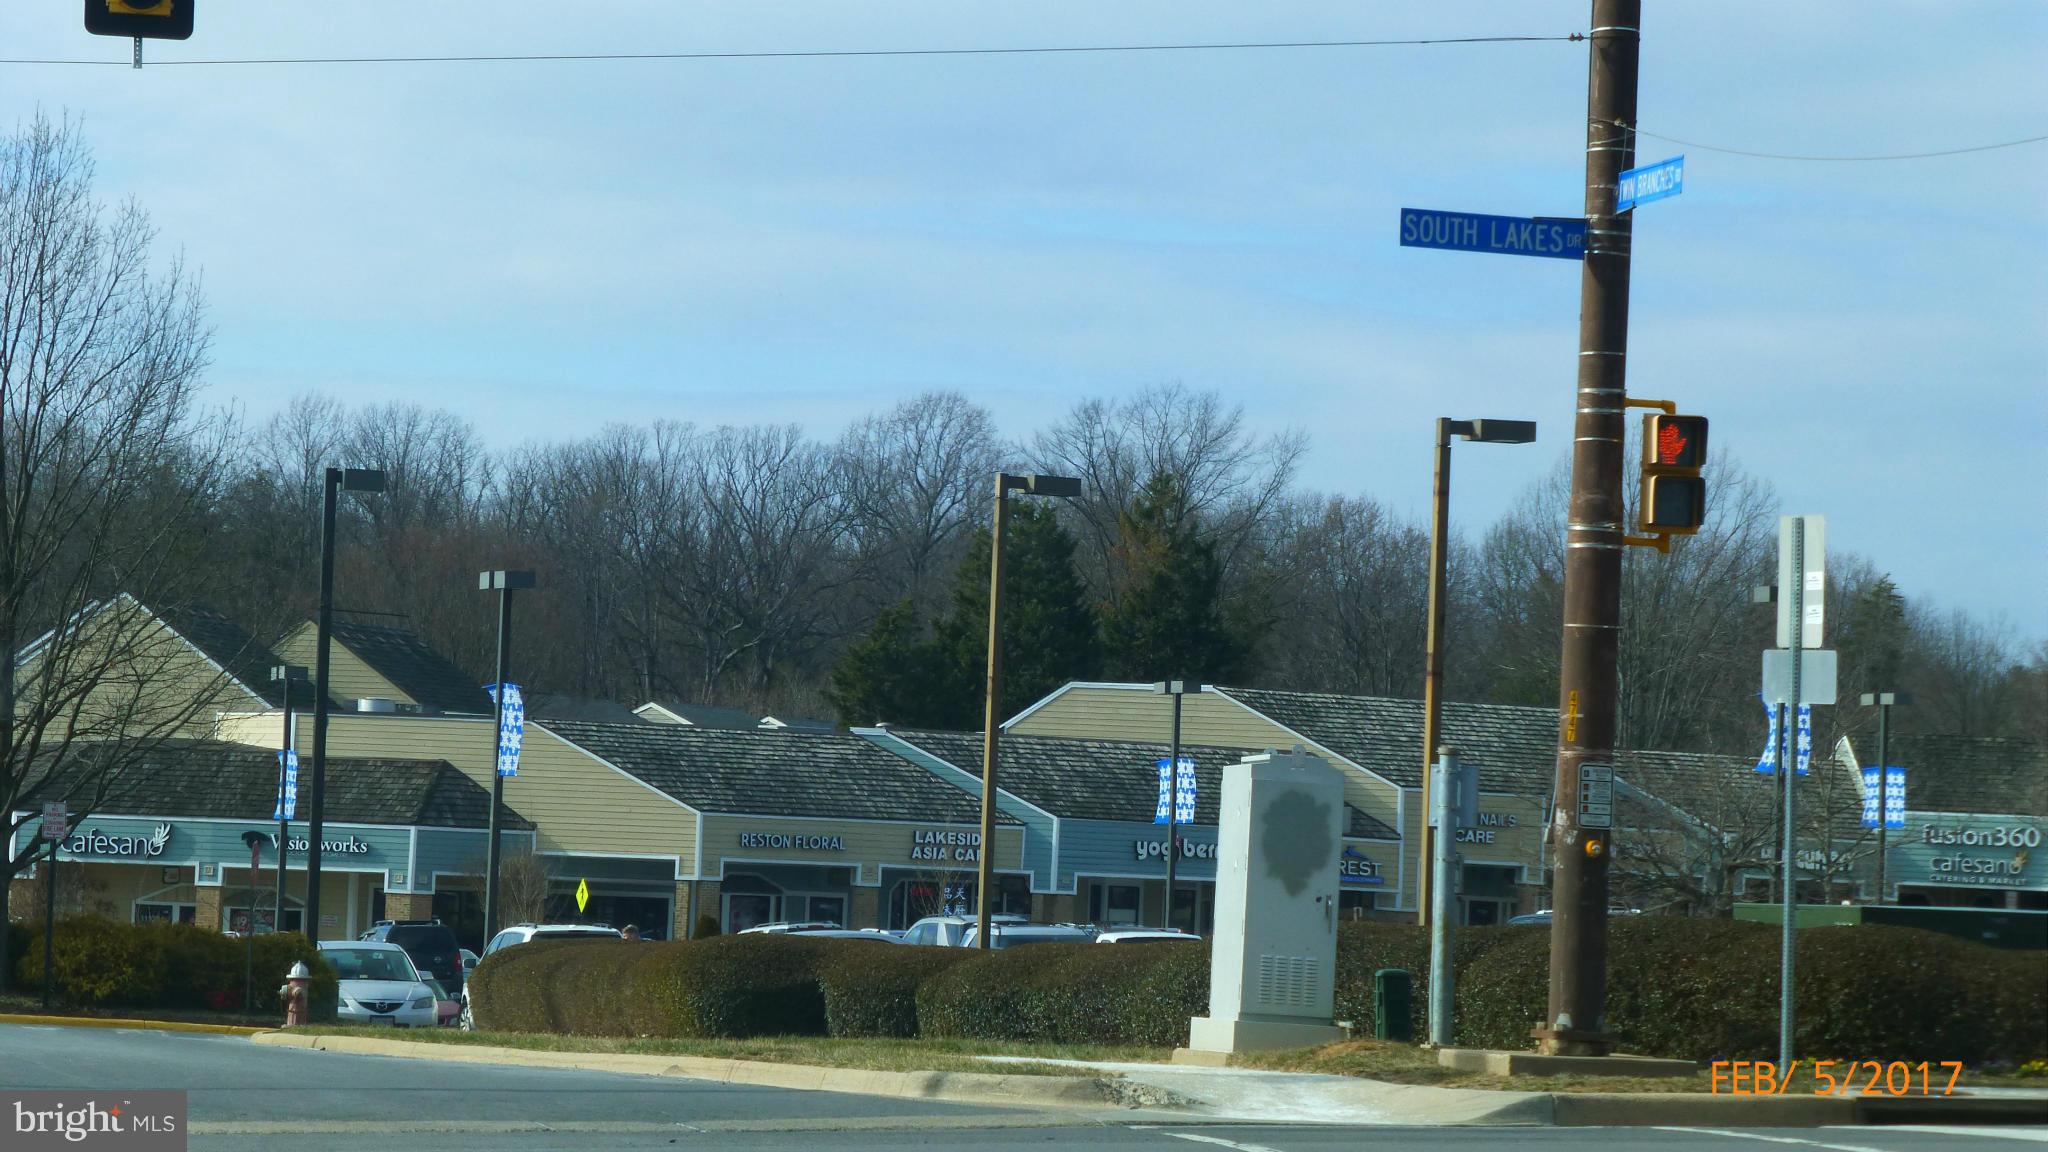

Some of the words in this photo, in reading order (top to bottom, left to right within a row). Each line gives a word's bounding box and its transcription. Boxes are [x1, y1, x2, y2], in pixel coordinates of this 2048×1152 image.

[1637, 166, 1674, 198] BRANCHES
[1404, 213, 1478, 247] SOUTH
[1491, 220, 1563, 253] LAKES
[1566, 232, 1583, 249] DR
[61, 827, 166, 857] cafesano
[270, 833, 368, 853] Vsioworks
[741, 833, 791, 849] RESTON
[795, 835, 846, 850] FLORAL
[915, 830, 981, 846] LAKESID
[1456, 830, 1495, 844] CARE
[1922, 823, 2040, 848] fusion360
[912, 846, 948, 860] ASIA
[954, 848, 981, 862] CA
[1136, 837, 1218, 862] yogber
[1339, 860, 1383, 876] REST
[1930, 852, 2023, 875] cafesano
